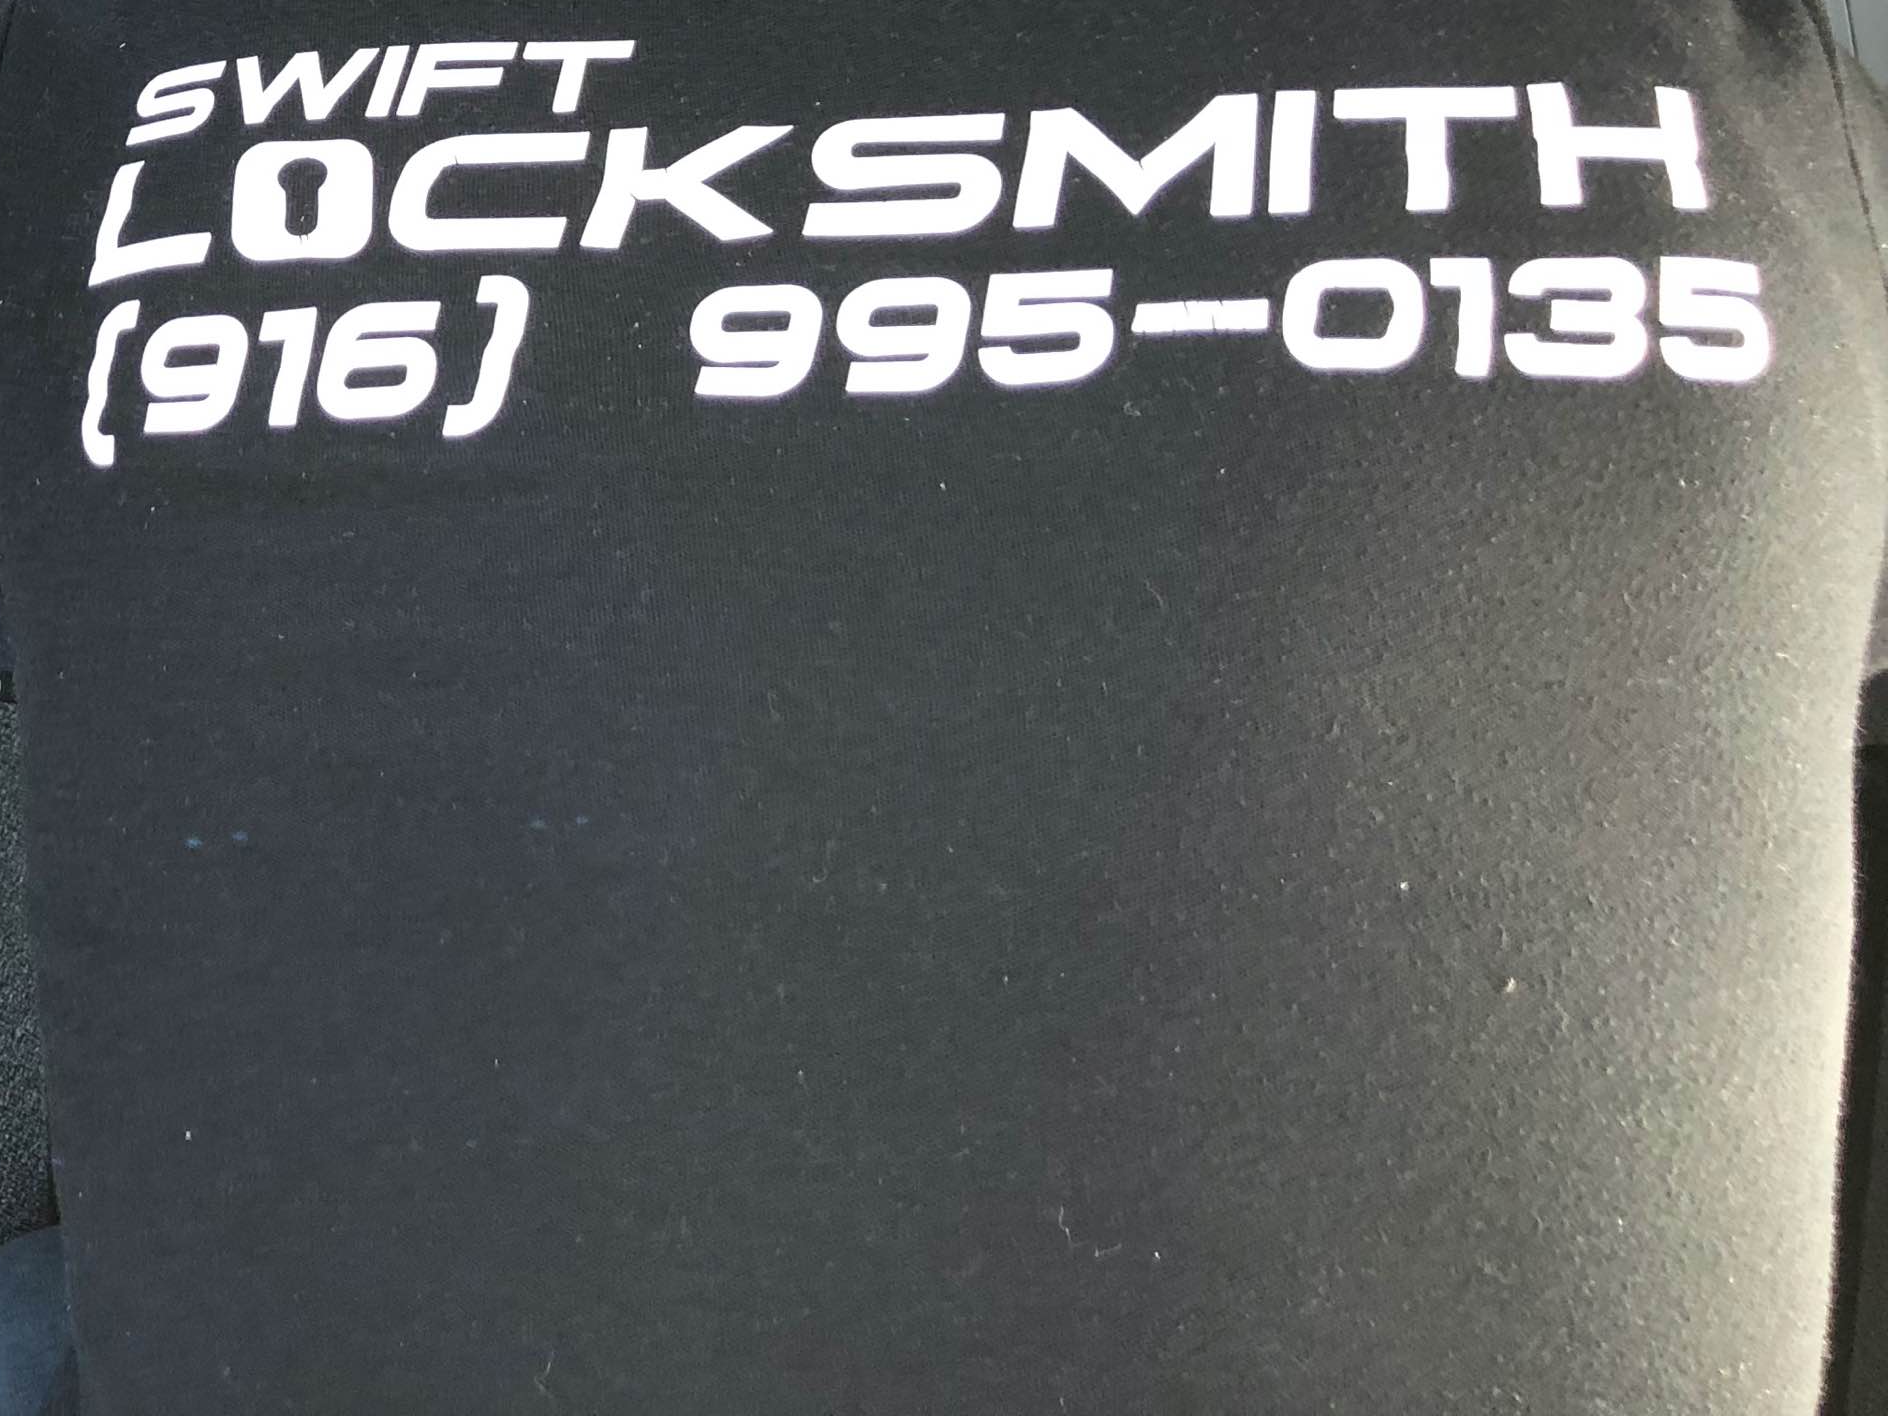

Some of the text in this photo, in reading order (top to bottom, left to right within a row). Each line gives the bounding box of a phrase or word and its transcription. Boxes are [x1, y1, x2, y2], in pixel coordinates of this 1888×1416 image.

[87, 81, 1718, 288] LOCKSMITH
[125, 39, 636, 147] SWIFT
[80, 256, 1775, 468] (916) 995-0135
